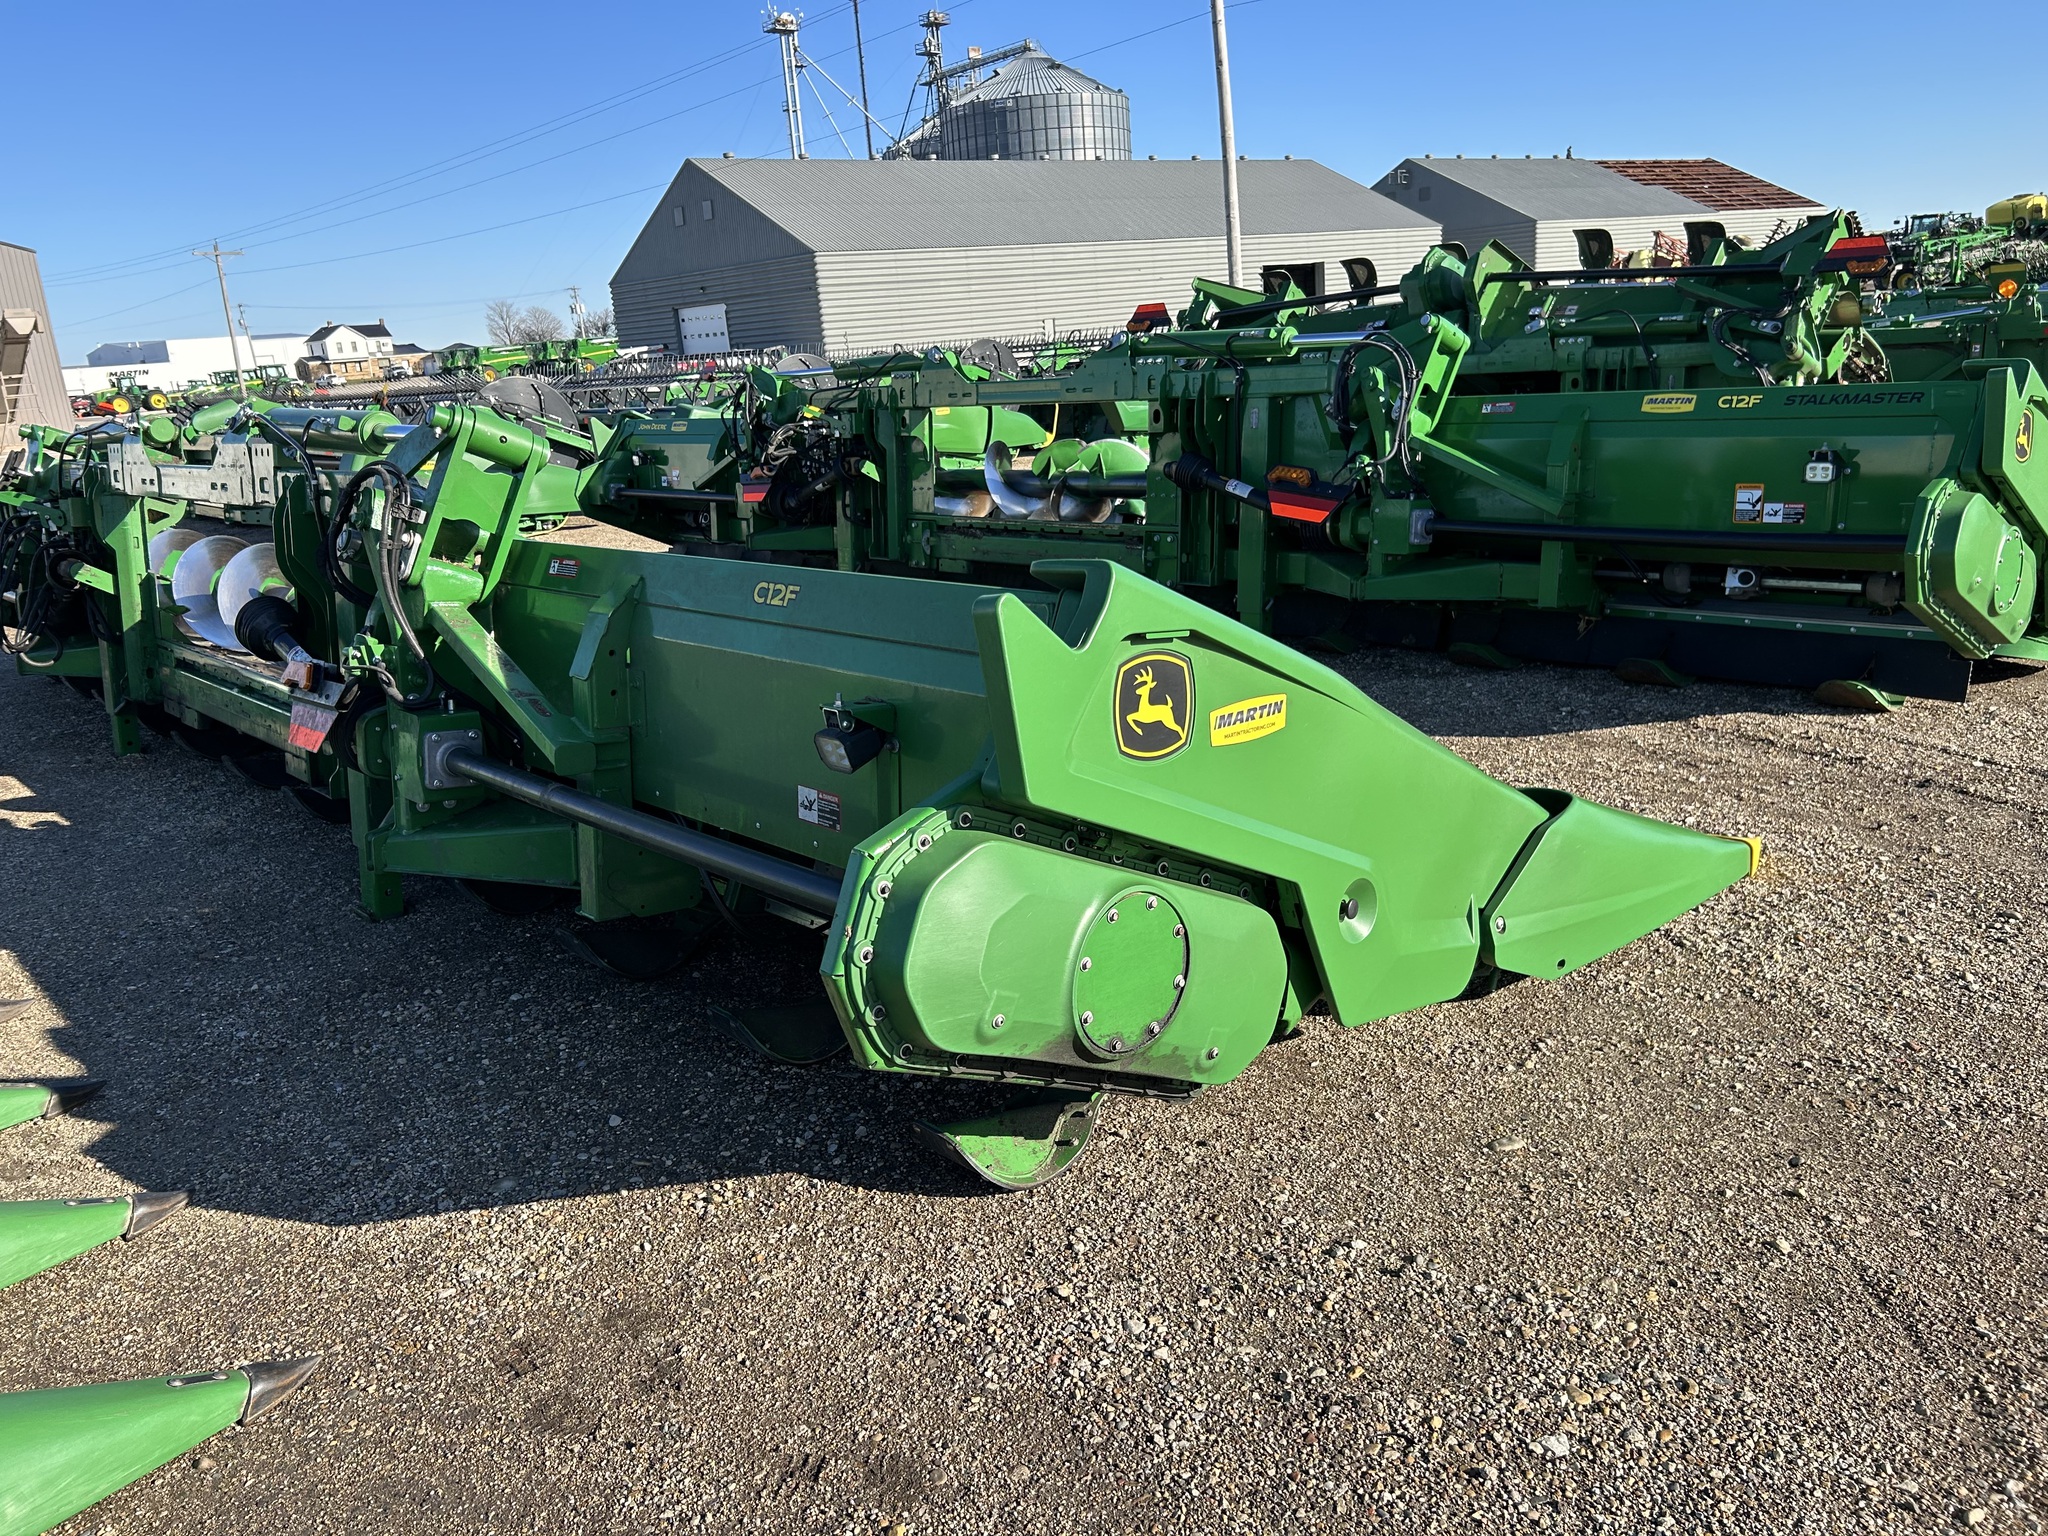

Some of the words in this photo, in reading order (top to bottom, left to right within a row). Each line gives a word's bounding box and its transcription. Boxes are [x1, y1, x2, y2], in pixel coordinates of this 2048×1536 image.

[108, 369, 149, 378] MARTIN
[1646, 397, 1695, 405] MARTIN
[1717, 395, 1763, 408] C12F
[1784, 391, 1925, 407] STALKMASTER
[753, 581, 801, 607] C12F
[1217, 700, 1284, 730] MARTIN
